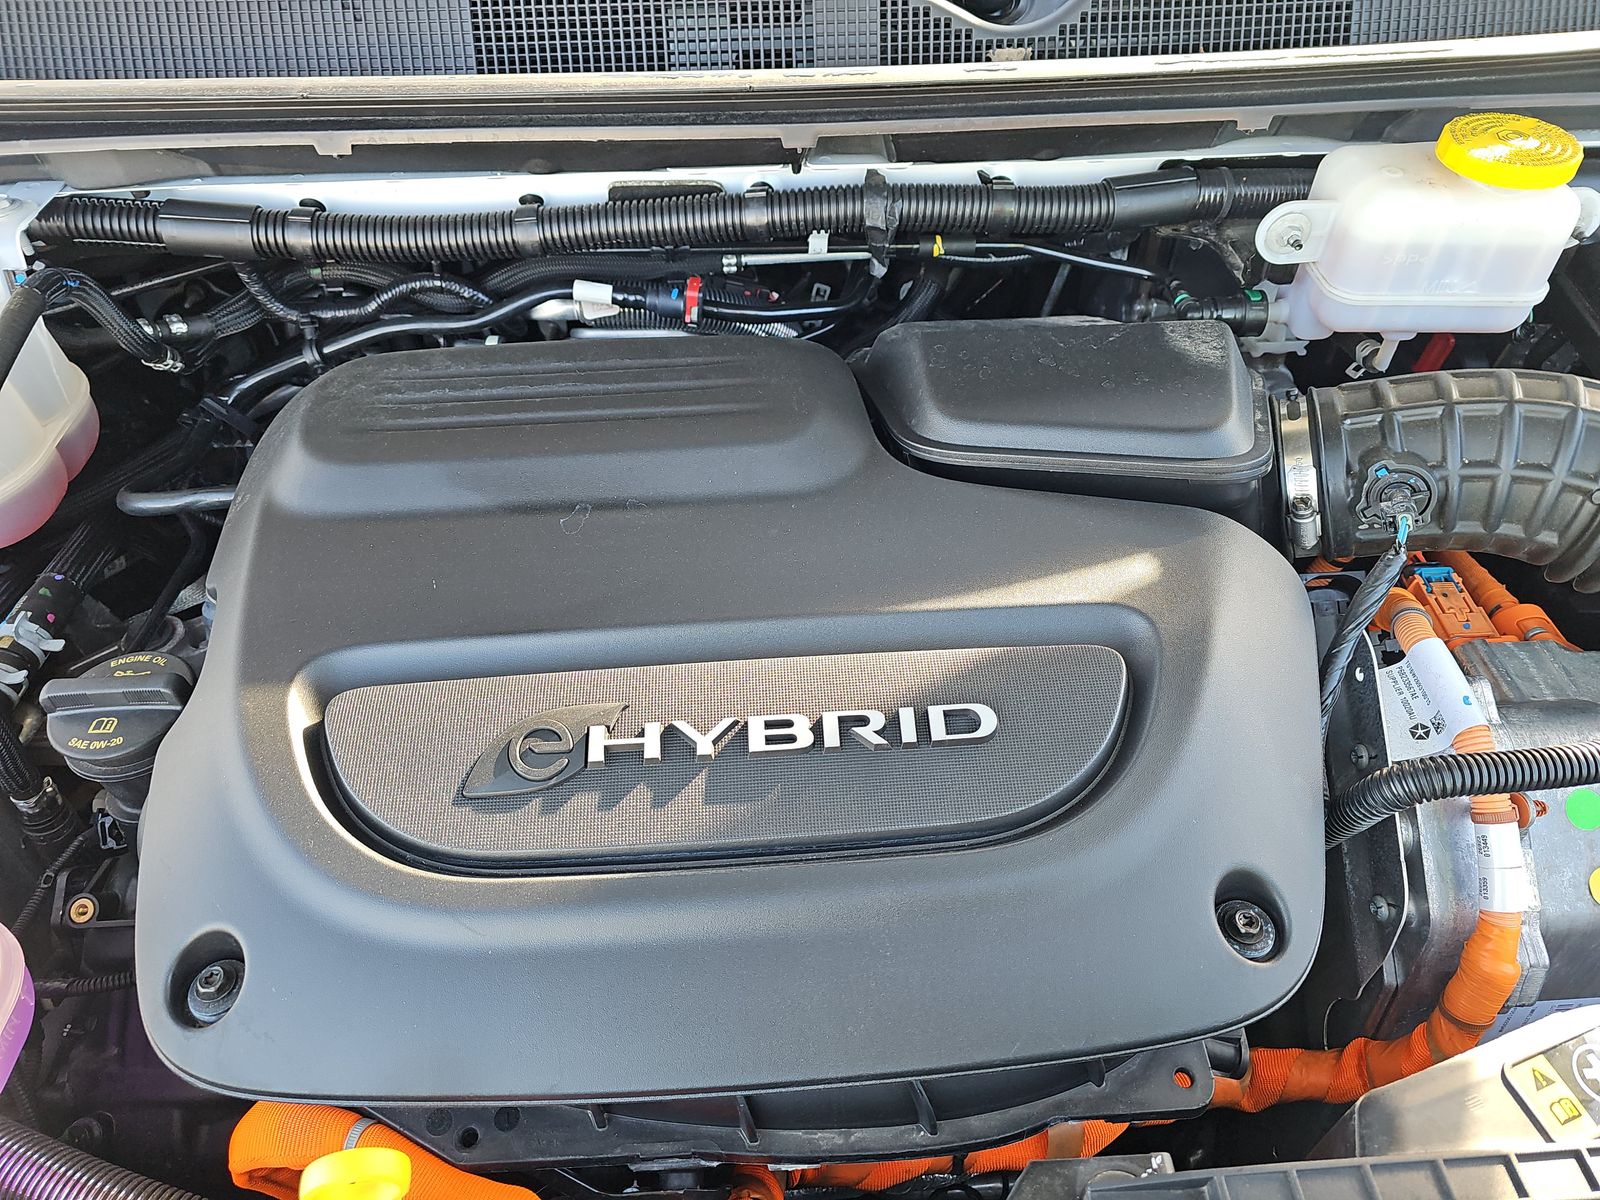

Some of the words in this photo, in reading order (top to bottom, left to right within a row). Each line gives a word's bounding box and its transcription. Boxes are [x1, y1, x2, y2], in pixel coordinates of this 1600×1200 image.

[110, 654, 152, 668] ENGINE
[153, 656, 168, 667] OIL
[1385, 669, 1405, 697] SUPPLIER
[68, 737, 90, 750] SAE
[89, 736, 124, 750] 0W-20
[1481, 834, 1491, 858] 013449
